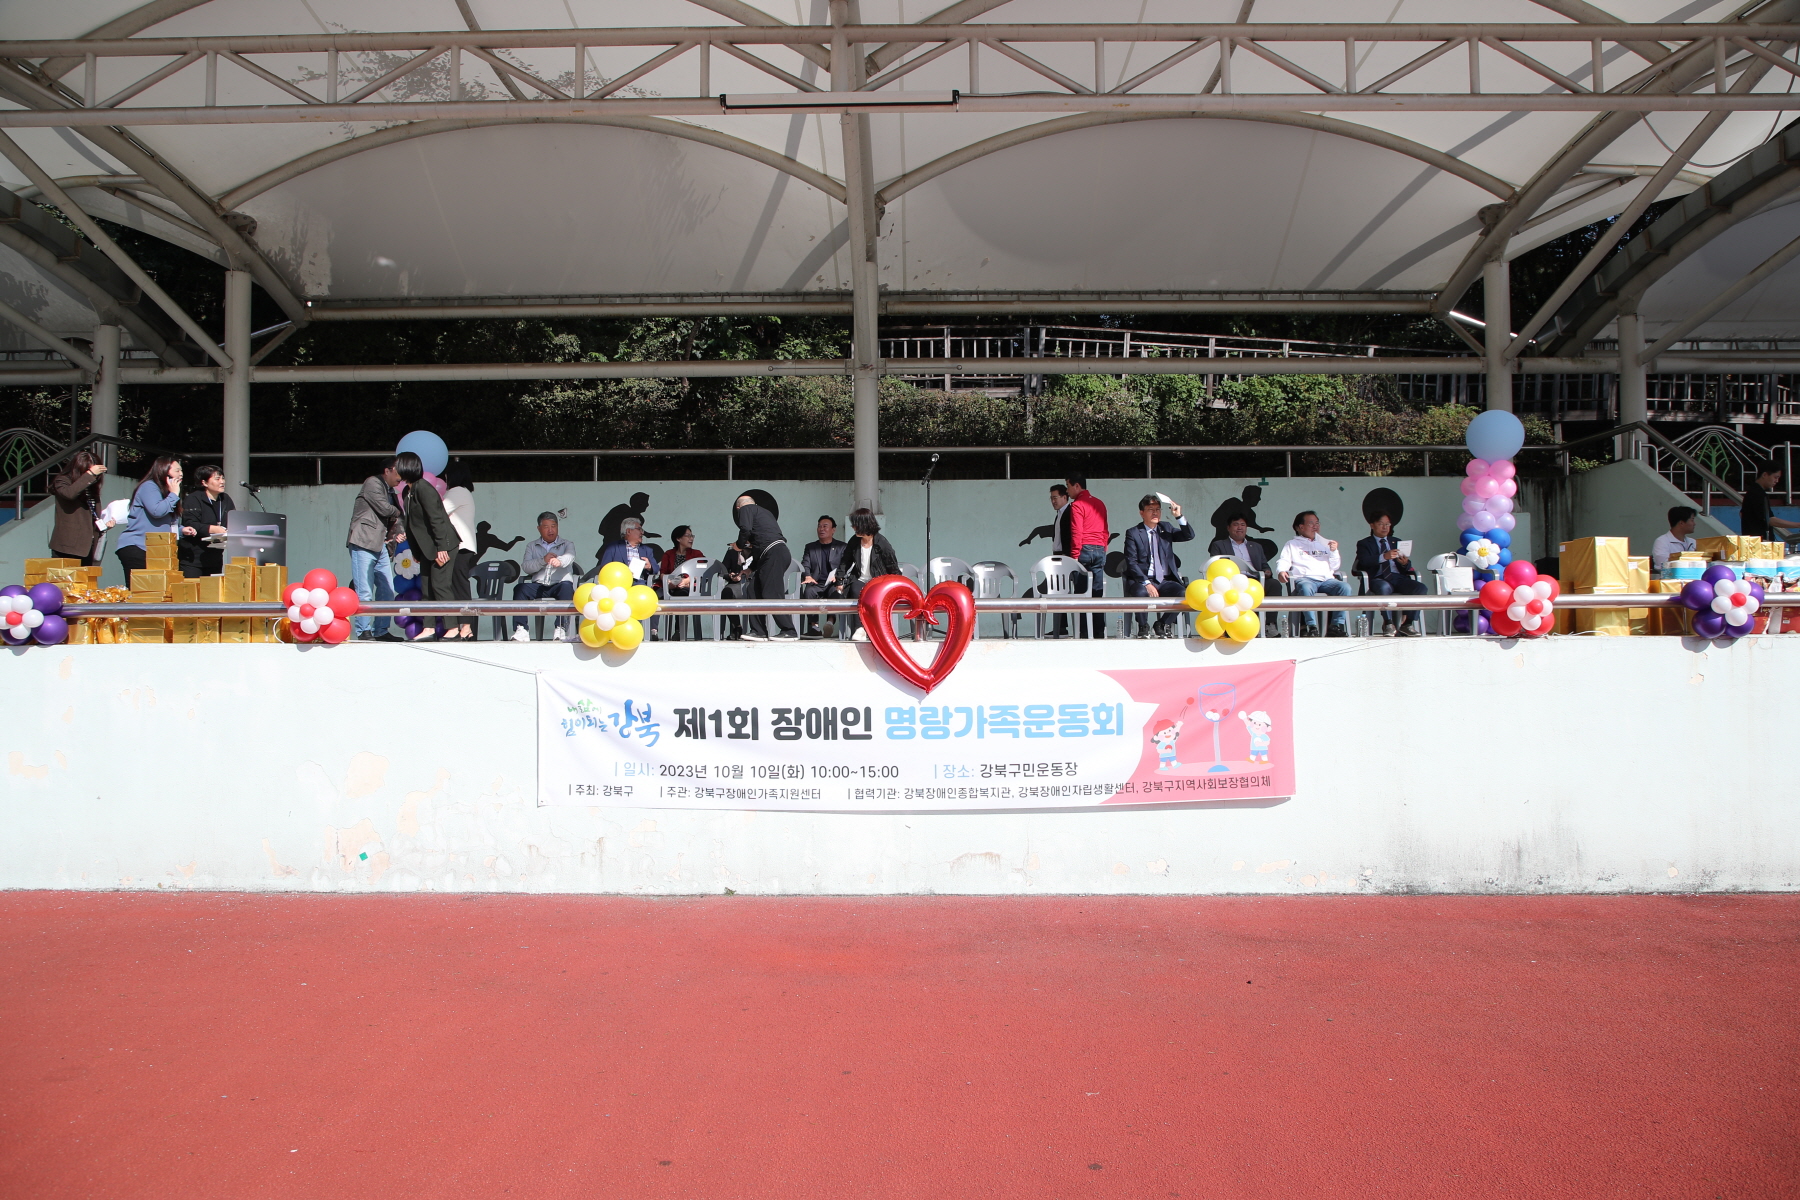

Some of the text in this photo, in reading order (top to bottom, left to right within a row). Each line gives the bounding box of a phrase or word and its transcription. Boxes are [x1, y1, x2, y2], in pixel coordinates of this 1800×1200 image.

[607, 699, 660, 747] 강북
[673, 702, 1124, 741] 제1회 장애인 명랑가족운동회
[623, 762, 899, 780] 일시: 2023년 10월 10일(화) 10:00~15:00
[942, 762, 1079, 779] 장소: 강북구민운동장
[575, 784, 634, 797] 주최: 강북구
[666, 786, 821, 800] 주관: 강북구장애인가족지원센터
[854, 775, 1272, 800] 협력기관: 강북장애인종합복지관, 강북장애인자립생활센터, 강북구지역사회보장협의체
